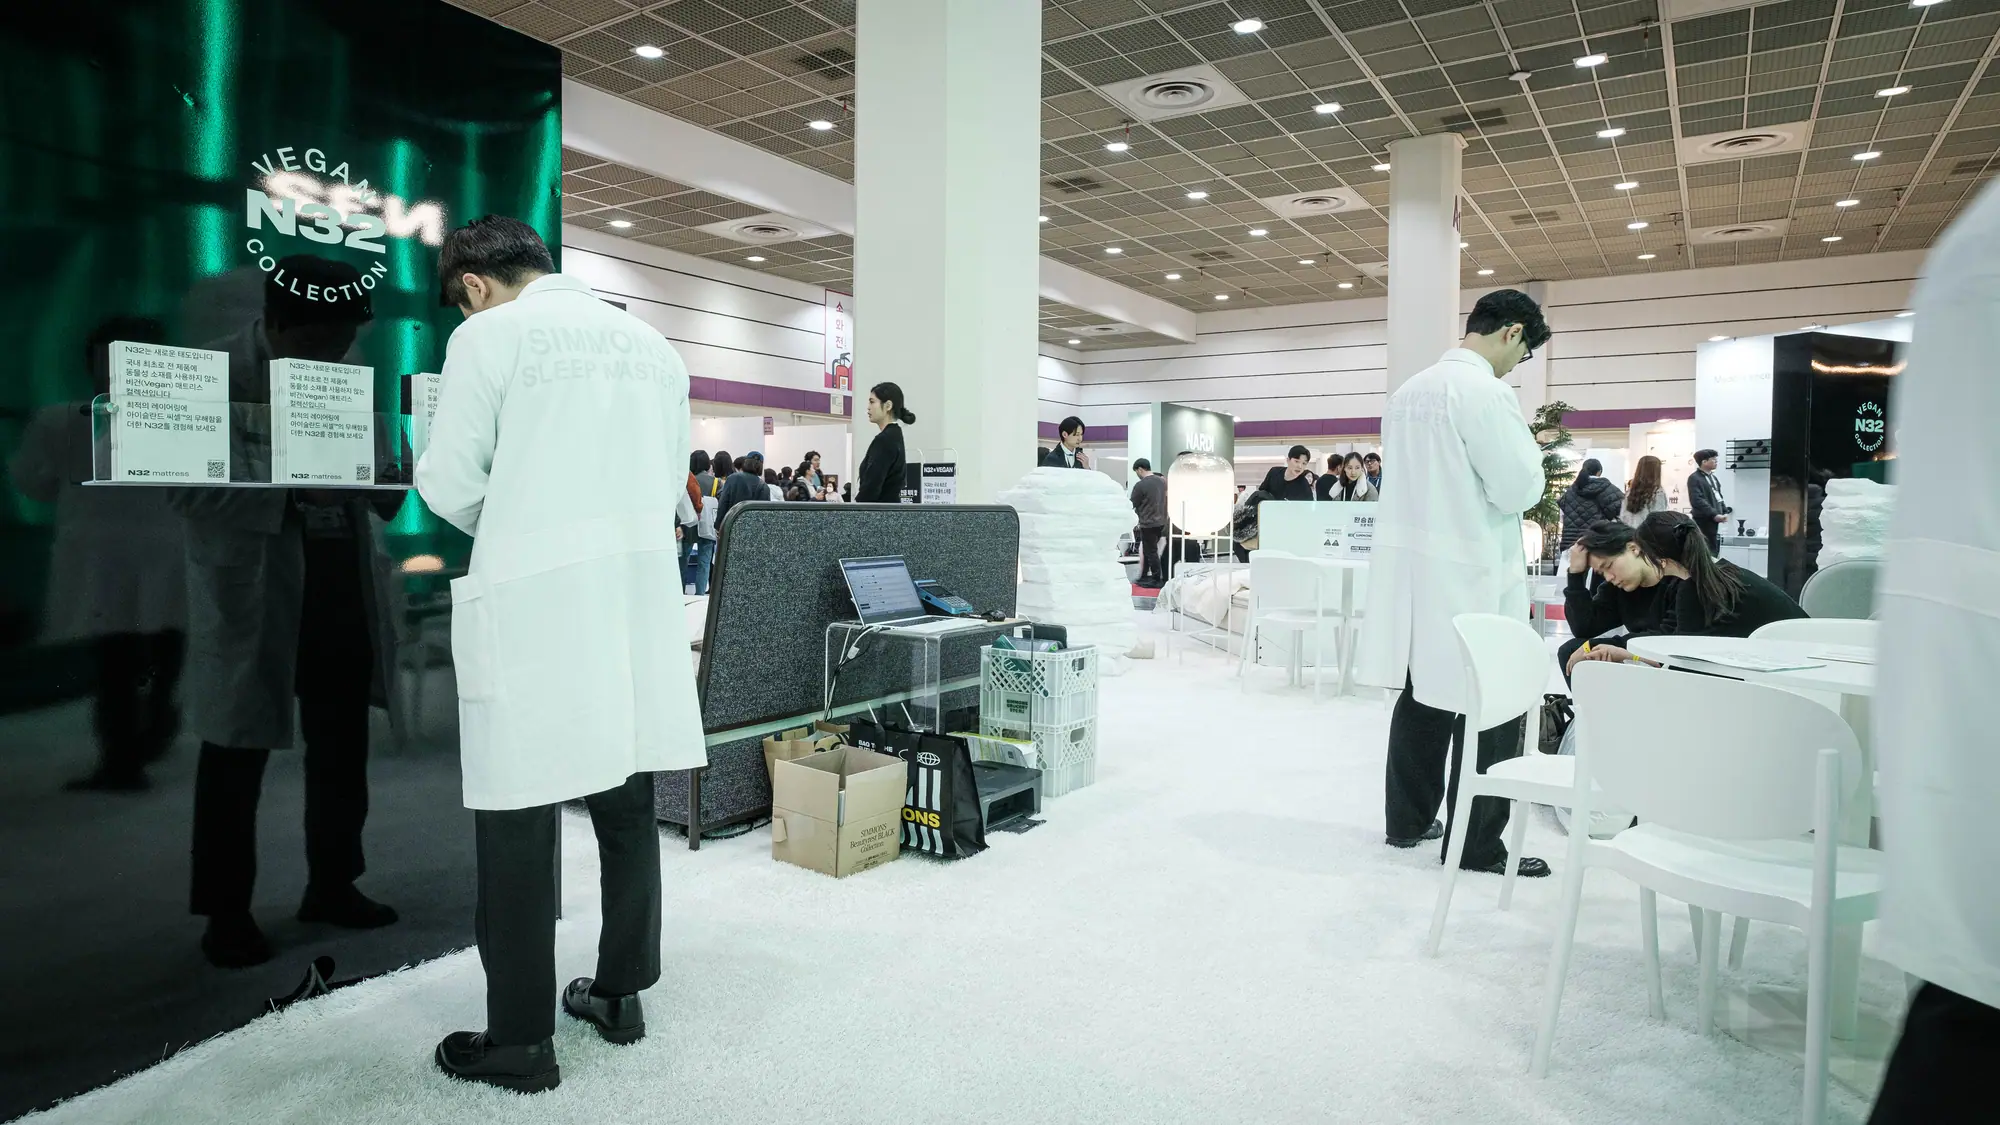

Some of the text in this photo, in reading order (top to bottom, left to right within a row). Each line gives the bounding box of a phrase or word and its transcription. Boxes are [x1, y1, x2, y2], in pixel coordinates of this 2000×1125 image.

[251, 146, 377, 202] VEGAN
[246, 188, 386, 254] N32
[246, 238, 388, 303] COLLECTION
[528, 327, 667, 364] SIMMONS
[125, 346, 214, 361] N32는 새로운 태도입니다
[125, 359, 198, 372] 국내 최초로 전 제품에
[289, 362, 361, 375] N32는 새로운 태도입니다
[125, 368, 219, 384] 동물성 소재를 사용하지 않는
[522, 359, 675, 391] SLEEP MASTER
[125, 378, 203, 391] 비건(Vegan) 매트리스
[126, 388, 171, 398] 컬렉션입니다
[126, 401, 188, 412] 최적의 레이어링에
[1856, 401, 1883, 418] VEGAN
[126, 411, 166, 421] 아이슬란드
[126, 420, 217, 433] 더한 N32를 경험해 보세요
[1855, 418, 1884, 433] N32
[1186, 430, 1215, 453] NARDI
[1854, 433, 1884, 452] COLLECTION
[127, 469, 190, 478] N32 mattress
[311, 473, 343, 481] mattress
[902, 807, 940, 829] ONS
[860, 822, 887, 838] SIMMONS
[849, 827, 896, 850] Beautyrest BLACK
[860, 841, 885, 854] Collection
